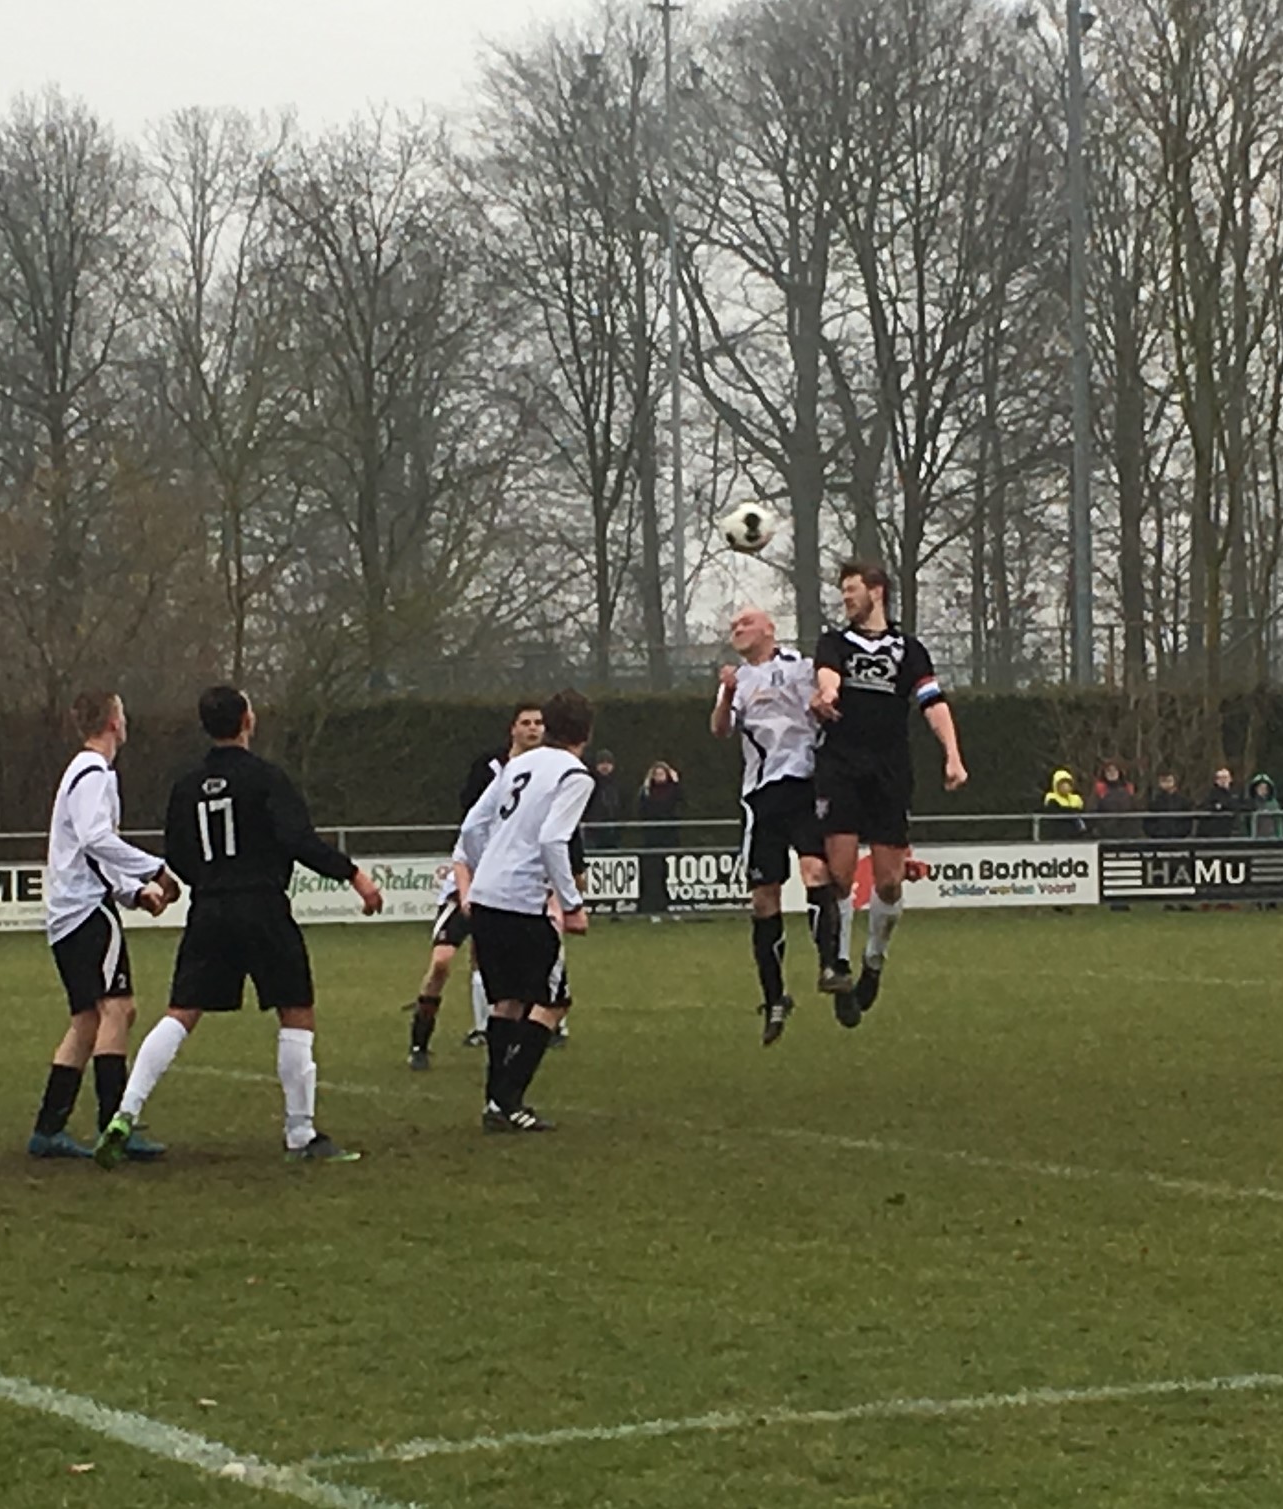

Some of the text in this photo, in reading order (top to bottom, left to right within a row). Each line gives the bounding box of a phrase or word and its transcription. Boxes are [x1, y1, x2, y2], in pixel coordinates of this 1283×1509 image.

[499, 770, 531, 820] 3
[197, 797, 236, 862] 17
[665, 854, 747, 885] 100%
[925, 864, 974, 882] van
